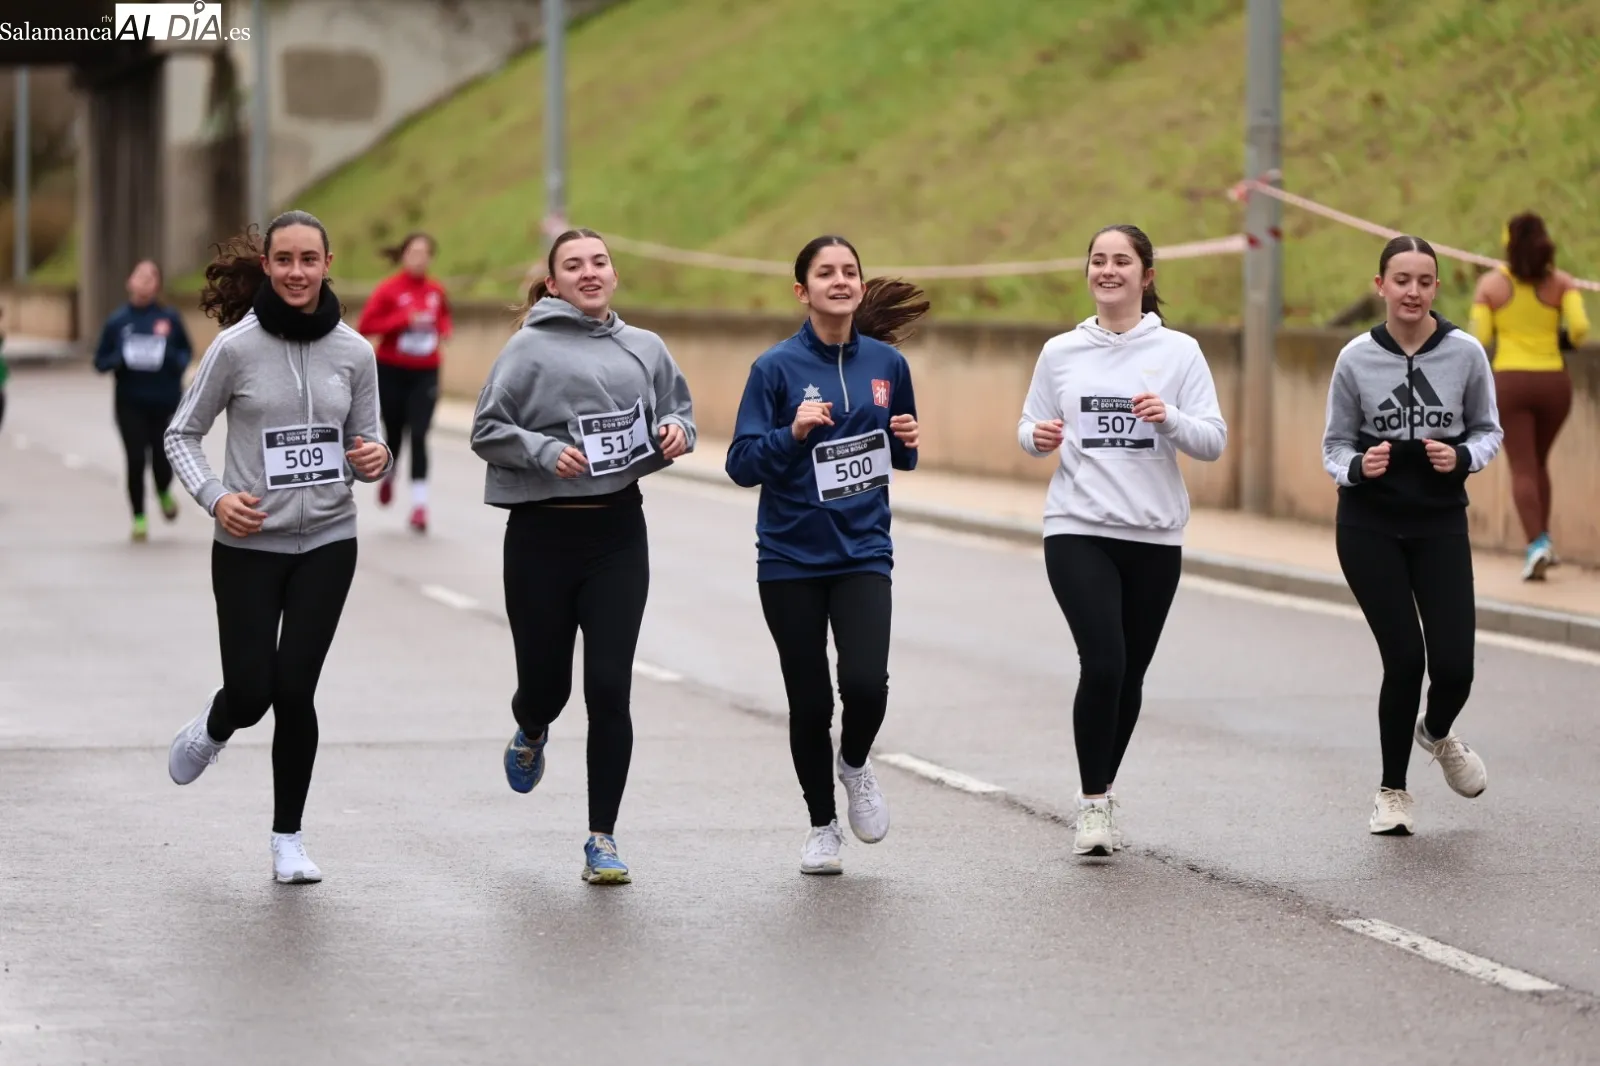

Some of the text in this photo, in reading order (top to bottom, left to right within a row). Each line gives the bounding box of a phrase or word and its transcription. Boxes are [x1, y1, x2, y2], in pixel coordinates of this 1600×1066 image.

[1098, 416, 1137, 434] 507
[1373, 406, 1454, 432] adidas
[285, 447, 323, 469] 509
[835, 457, 872, 482] 500
